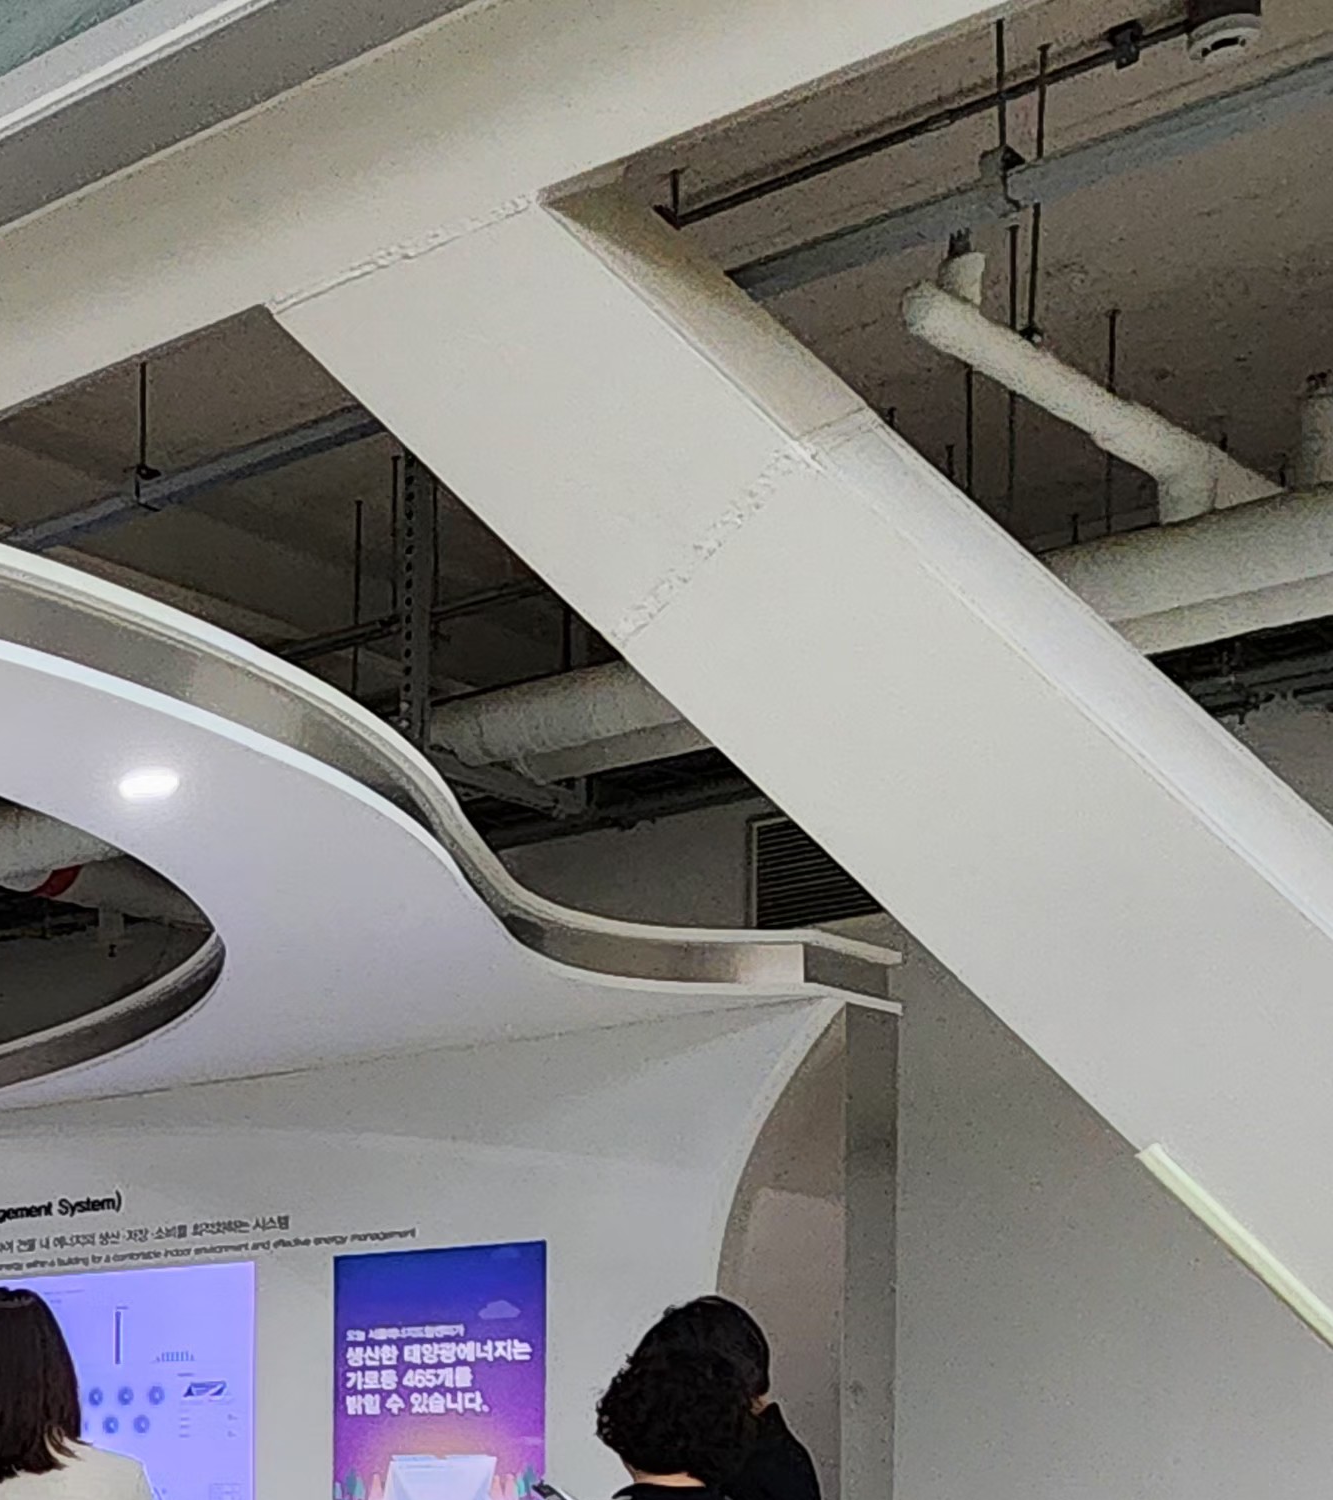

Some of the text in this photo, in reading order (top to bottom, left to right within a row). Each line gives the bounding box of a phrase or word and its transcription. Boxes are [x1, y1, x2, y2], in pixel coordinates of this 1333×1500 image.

[56, 1190, 122, 1216] System)
[346, 1338, 532, 1367] 생산한 태양광에너지는
[346, 1365, 474, 1391] 가로등 465개를
[385, 1392, 406, 1415] 수
[410, 1390, 490, 1414] 있습니다.
